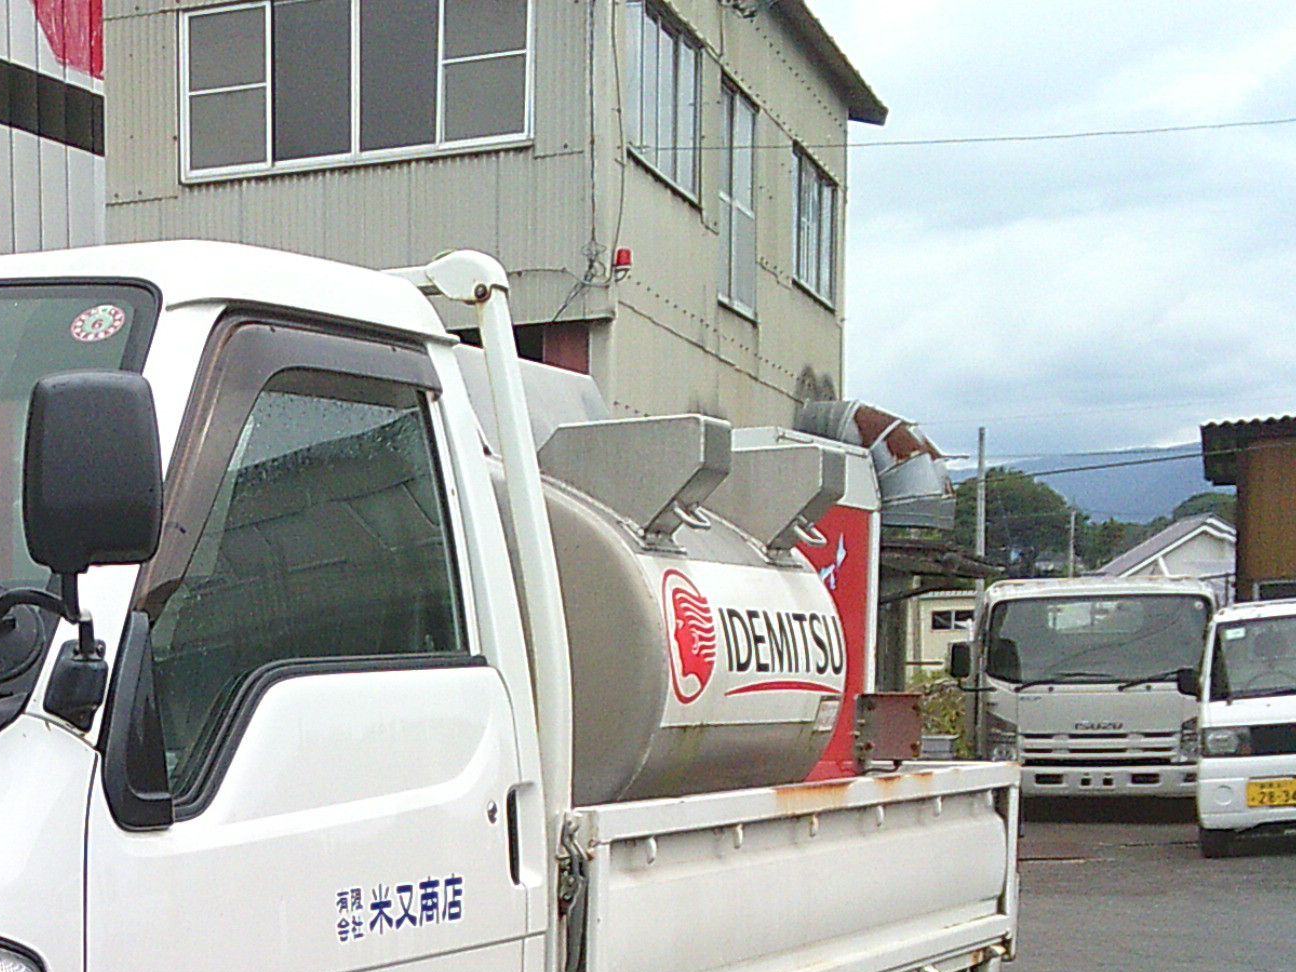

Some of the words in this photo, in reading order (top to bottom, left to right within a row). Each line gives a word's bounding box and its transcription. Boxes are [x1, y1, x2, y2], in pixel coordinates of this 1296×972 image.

[718, 607, 845, 675] IDEMITSU
[369, 873, 464, 935] 米又商店
